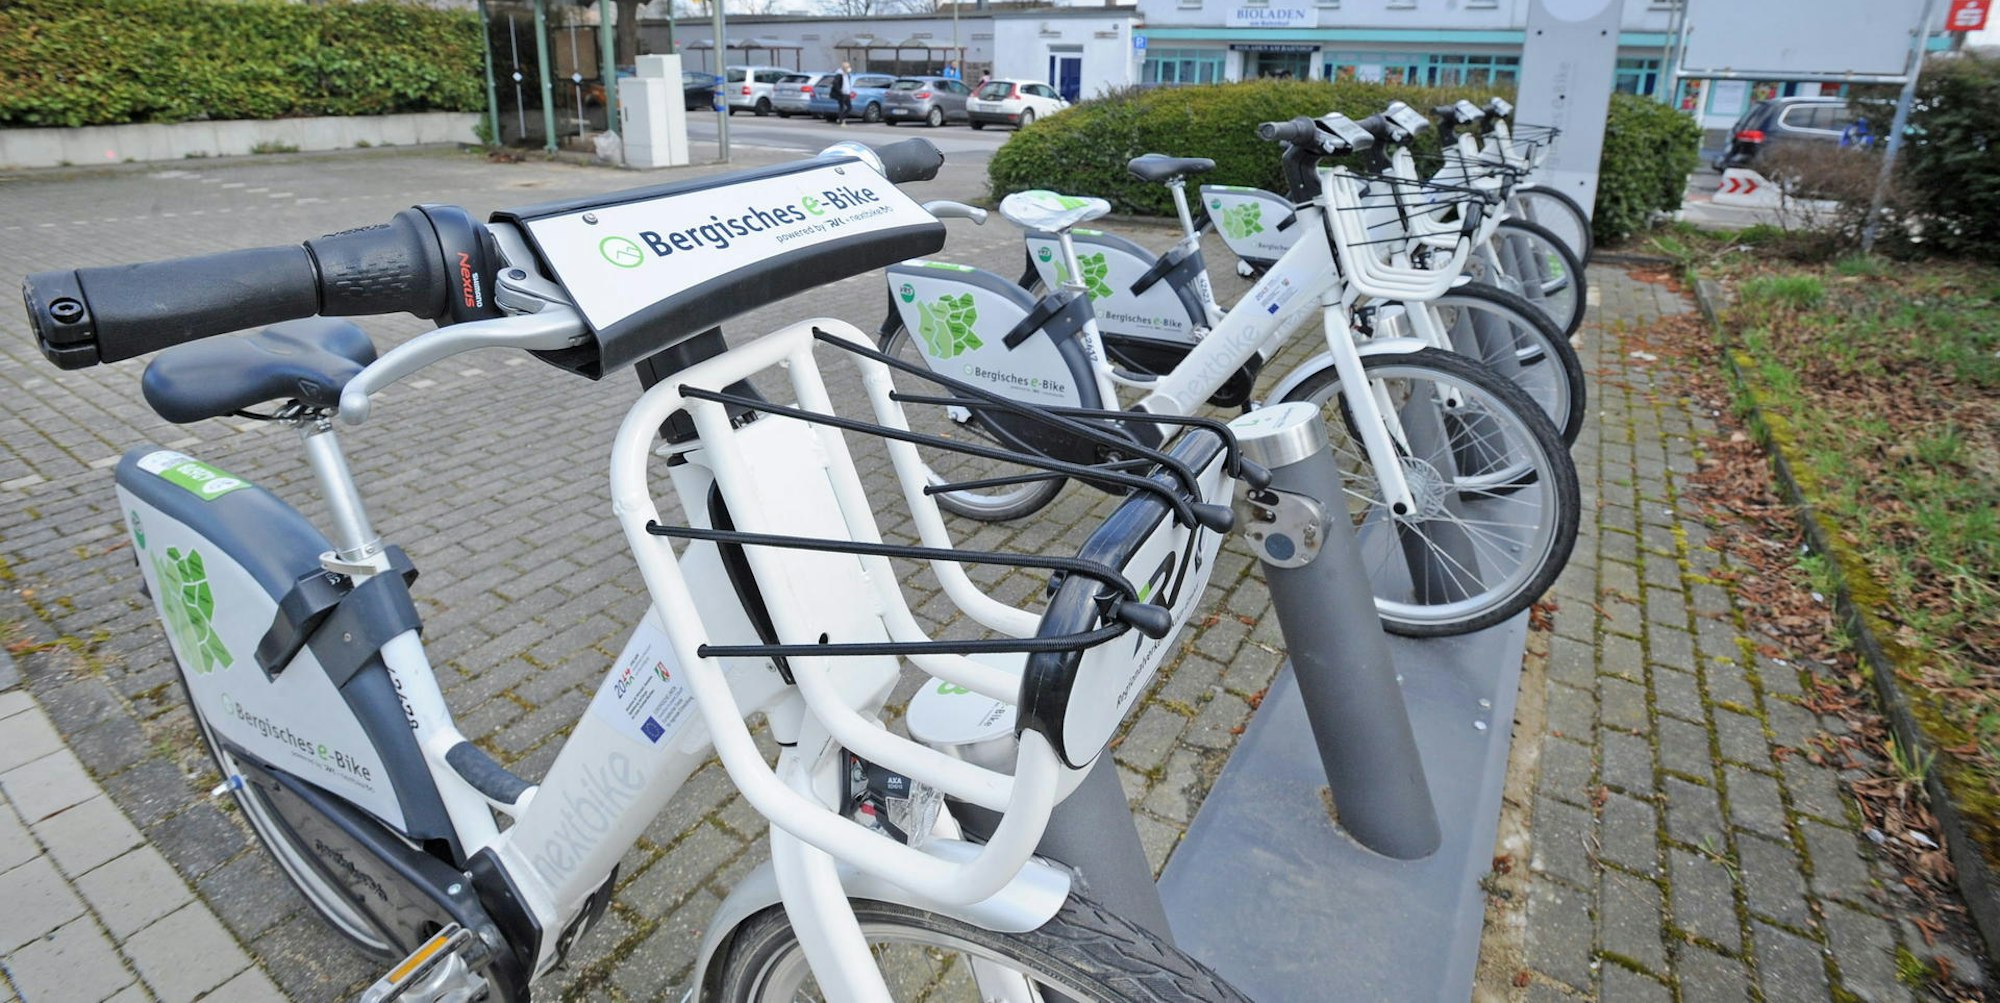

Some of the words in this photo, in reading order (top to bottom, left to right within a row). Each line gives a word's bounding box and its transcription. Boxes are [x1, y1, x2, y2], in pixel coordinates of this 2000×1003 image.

[1237, 9, 1306, 19] BIOLADEN
[639, 205, 806, 257] Bergisches
[801, 185, 880, 217] e-Bike
[776, 225, 815, 244] powered
[814, 223, 828, 233] by
[1258, 242, 1288, 251] Bergische
[1105, 311, 1151, 324] Bergisches
[1153, 316, 1182, 329] e-Bike
[1174, 324, 1260, 408] nextbike
[975, 366, 1029, 387] Bergisches
[1031, 377, 1065, 393] e-Bike
[235, 702, 315, 756] Bergisches
[317, 744, 372, 782] e-Bike
[887, 776, 902, 784] AXA
[534, 751, 647, 889] nextbike
